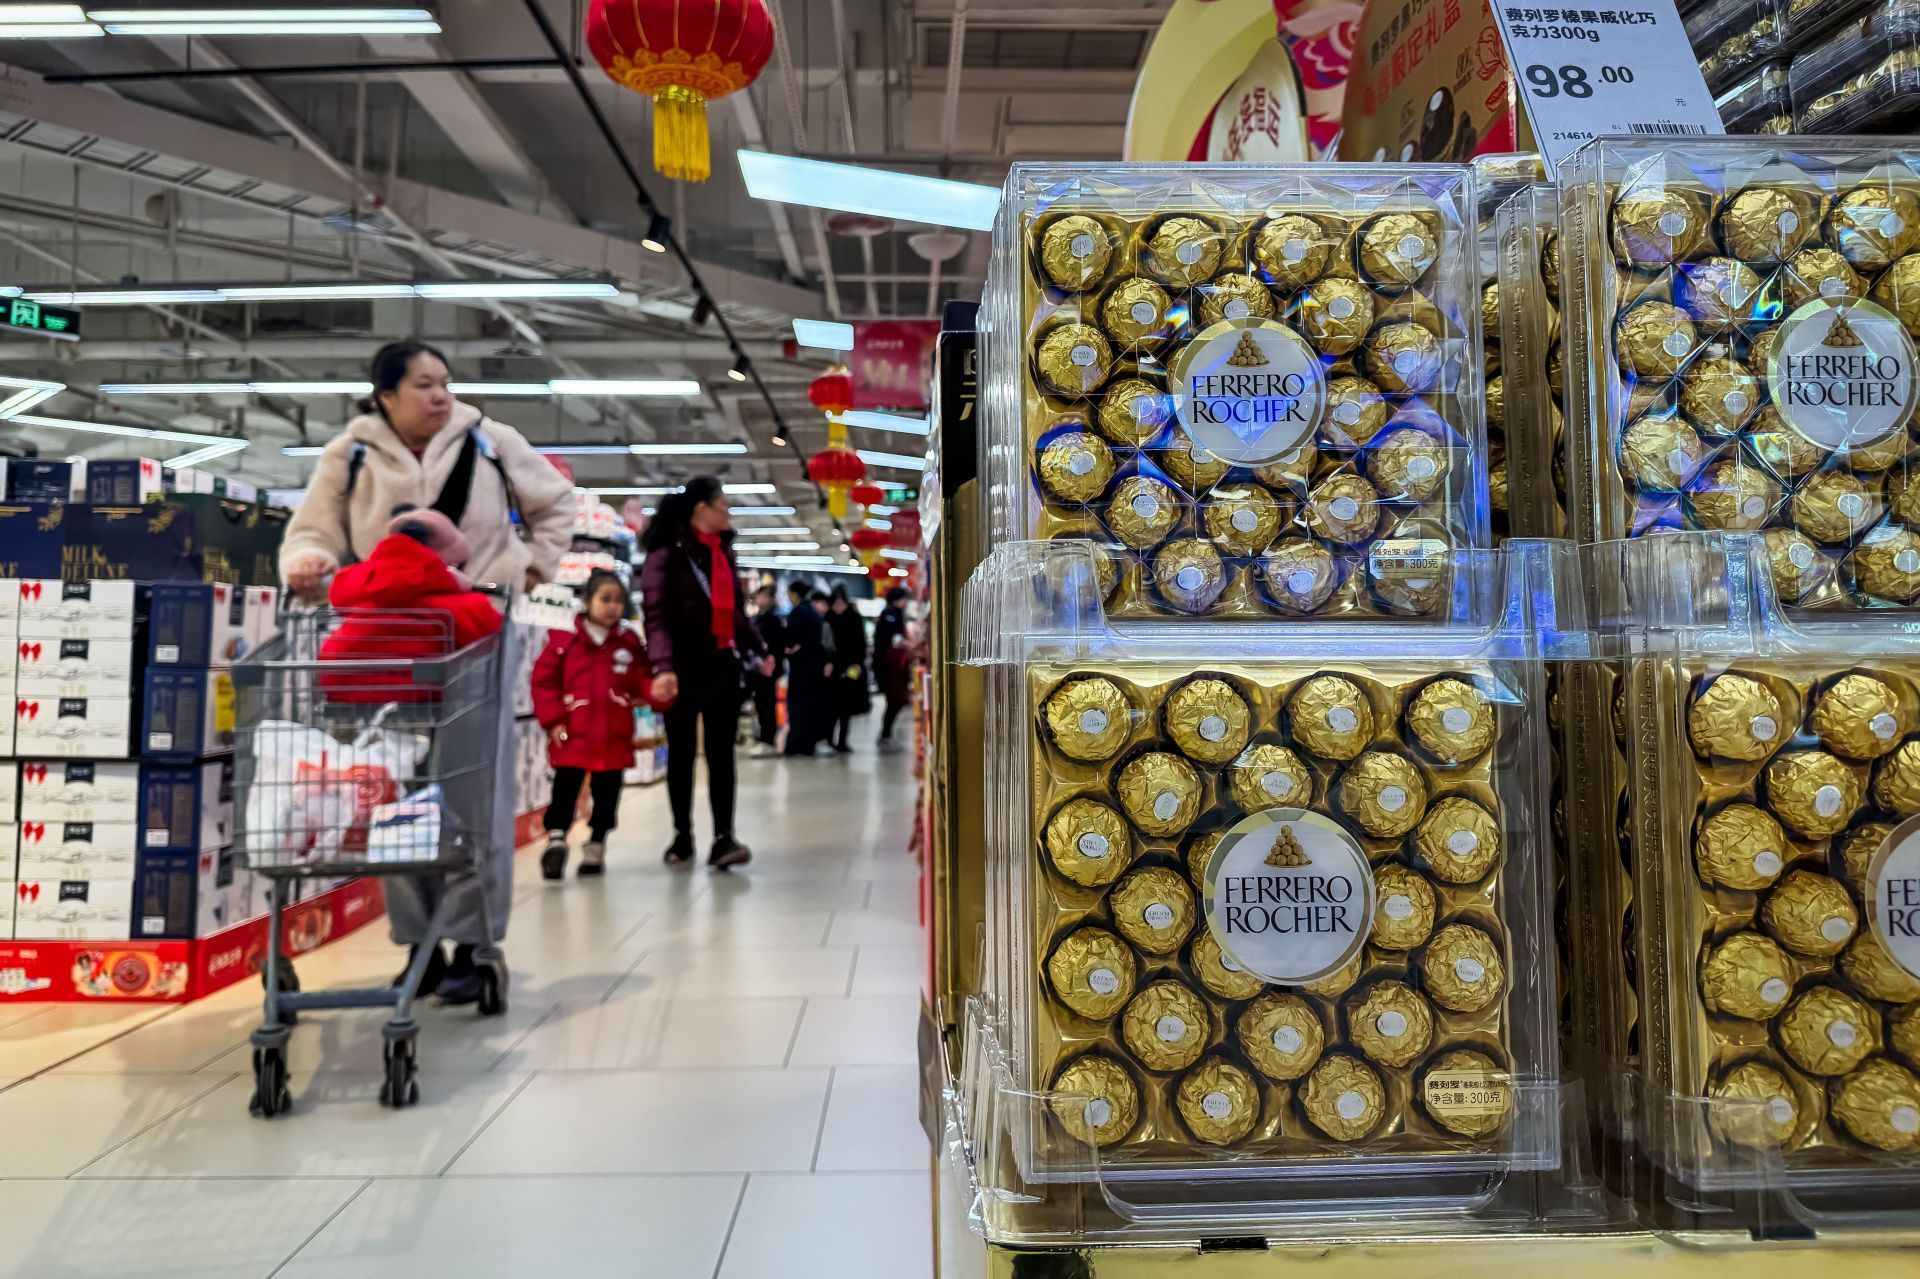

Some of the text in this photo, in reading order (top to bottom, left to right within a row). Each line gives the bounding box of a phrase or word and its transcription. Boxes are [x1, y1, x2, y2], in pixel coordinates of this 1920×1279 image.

[1505, 8, 1657, 25] 费列罗榛果威化巧
[1510, 24, 1600, 42] 克力300g
[1675, 98, 1687, 107] 元
[1553, 132, 1593, 140] 214614
[1787, 355, 1901, 380] FERRERO
[1191, 373, 1305, 398] FERRERO
[1788, 381, 1903, 407] ROCHER
[1193, 399, 1307, 424] ROCHER
[1224, 875, 1353, 904] FERRERO
[1226, 905, 1356, 934] ROCHER
